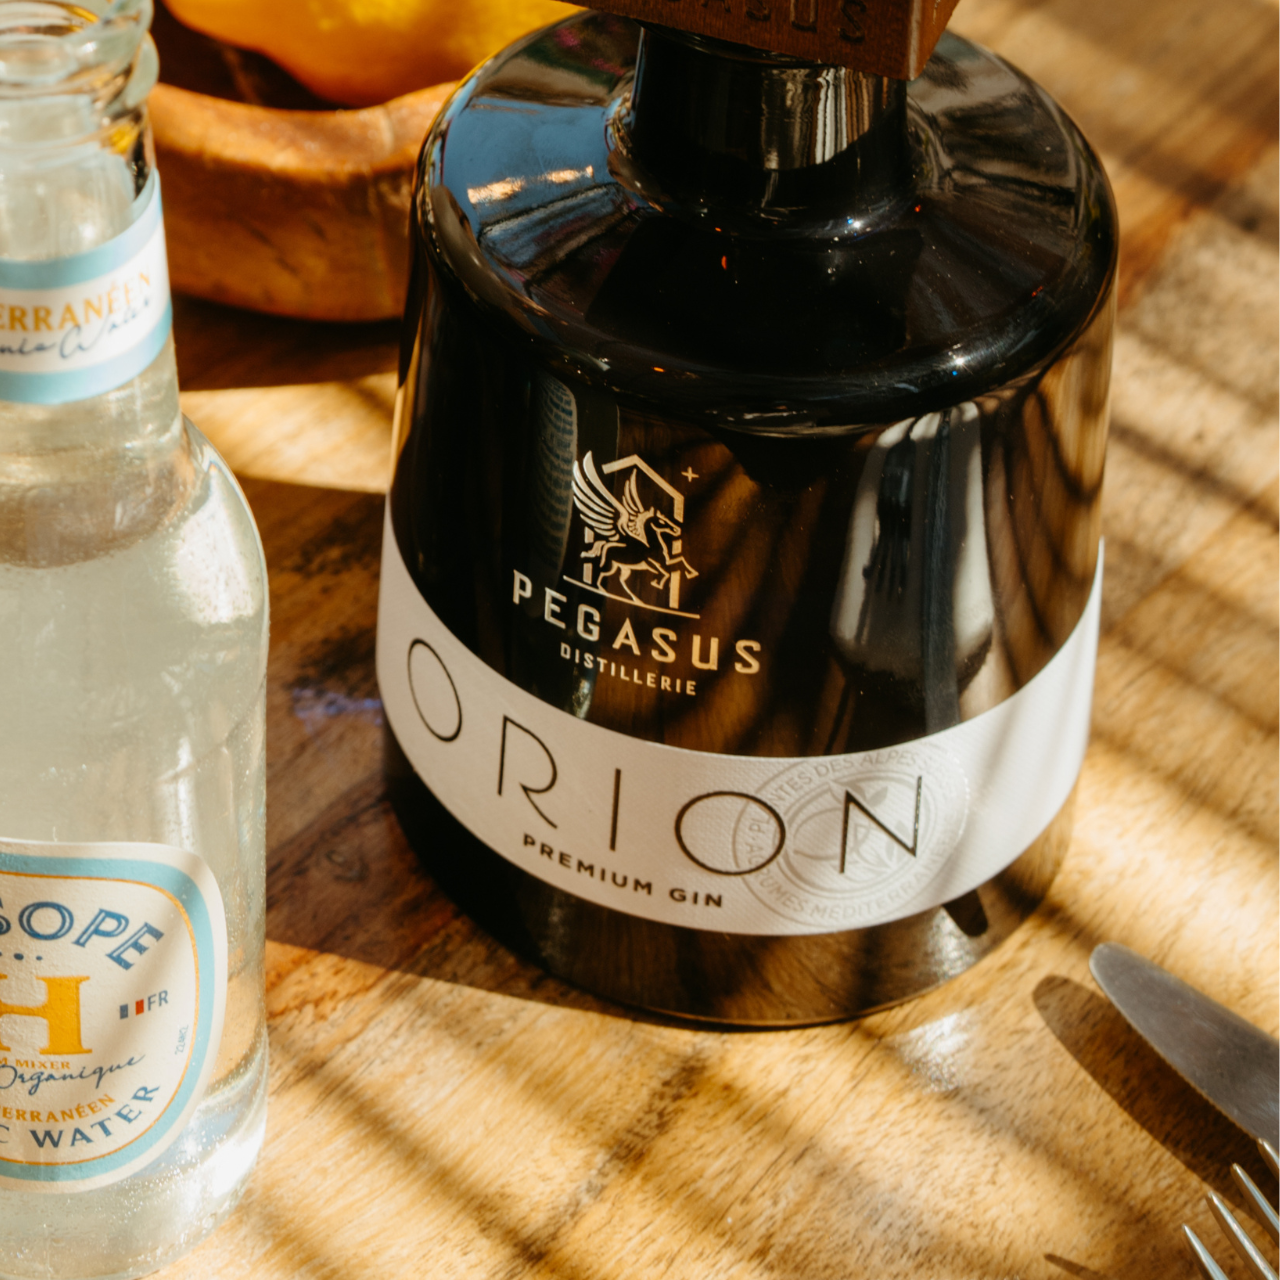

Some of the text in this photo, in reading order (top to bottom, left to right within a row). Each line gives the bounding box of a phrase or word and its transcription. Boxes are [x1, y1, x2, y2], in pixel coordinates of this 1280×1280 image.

[512, 568, 761, 675] PEGASUS
[560, 642, 697, 696] DISTILLERIE
[407, 637, 923, 876] ORION
[814, 756, 854, 776] DES
[523, 833, 722, 908] PREMIUM GIN
[147, 990, 170, 1011] FR
[15, 1058, 72, 1071] MIXER
[28, 1084, 161, 1149] WATER
